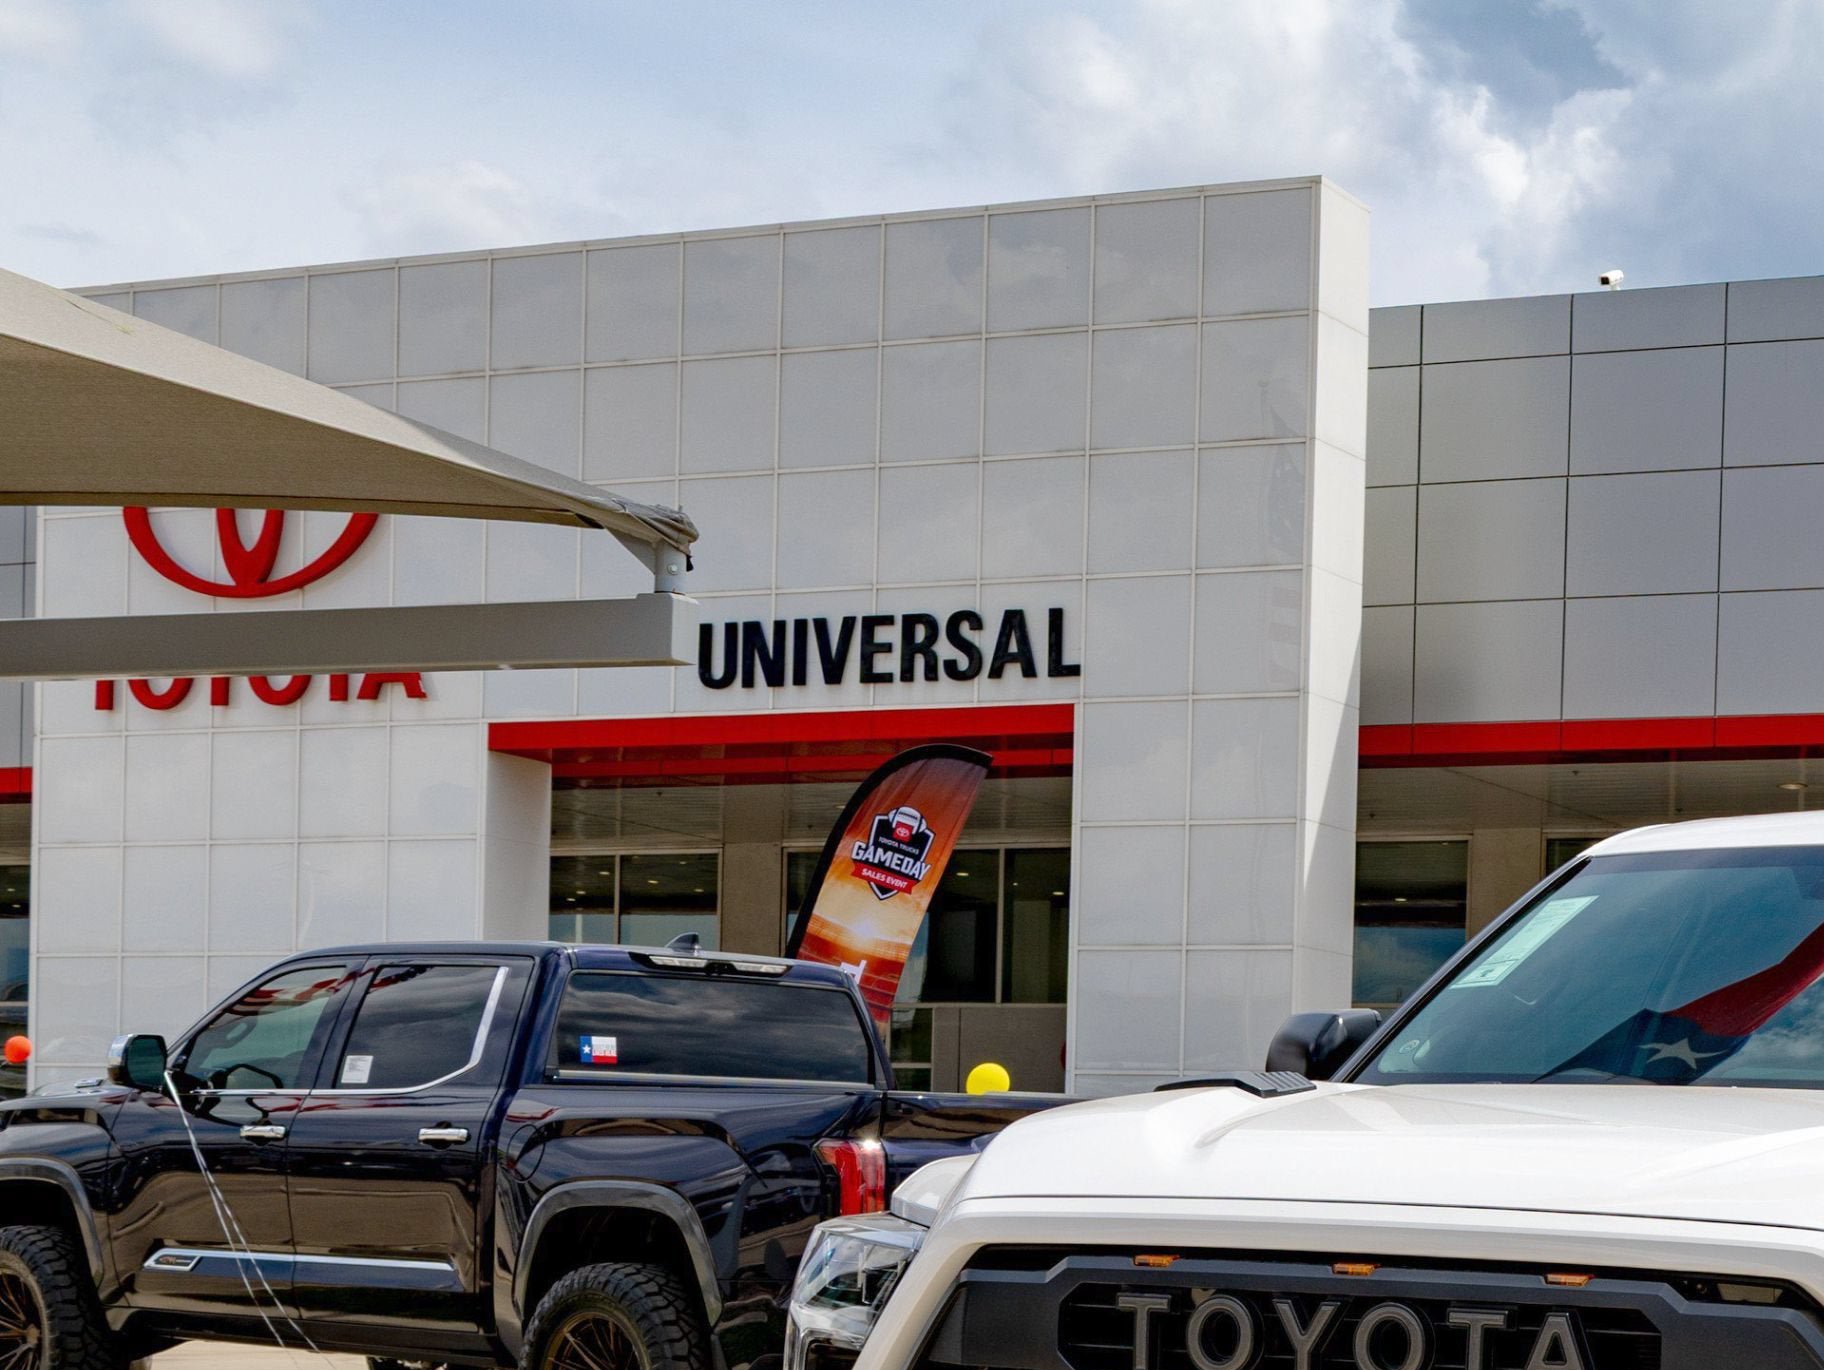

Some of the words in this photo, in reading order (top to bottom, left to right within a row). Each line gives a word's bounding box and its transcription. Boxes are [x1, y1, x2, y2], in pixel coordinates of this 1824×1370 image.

[698, 607, 1081, 689] UNIVERSAL
[861, 868, 886, 882] SALES
[886, 876, 908, 889] EVENT
